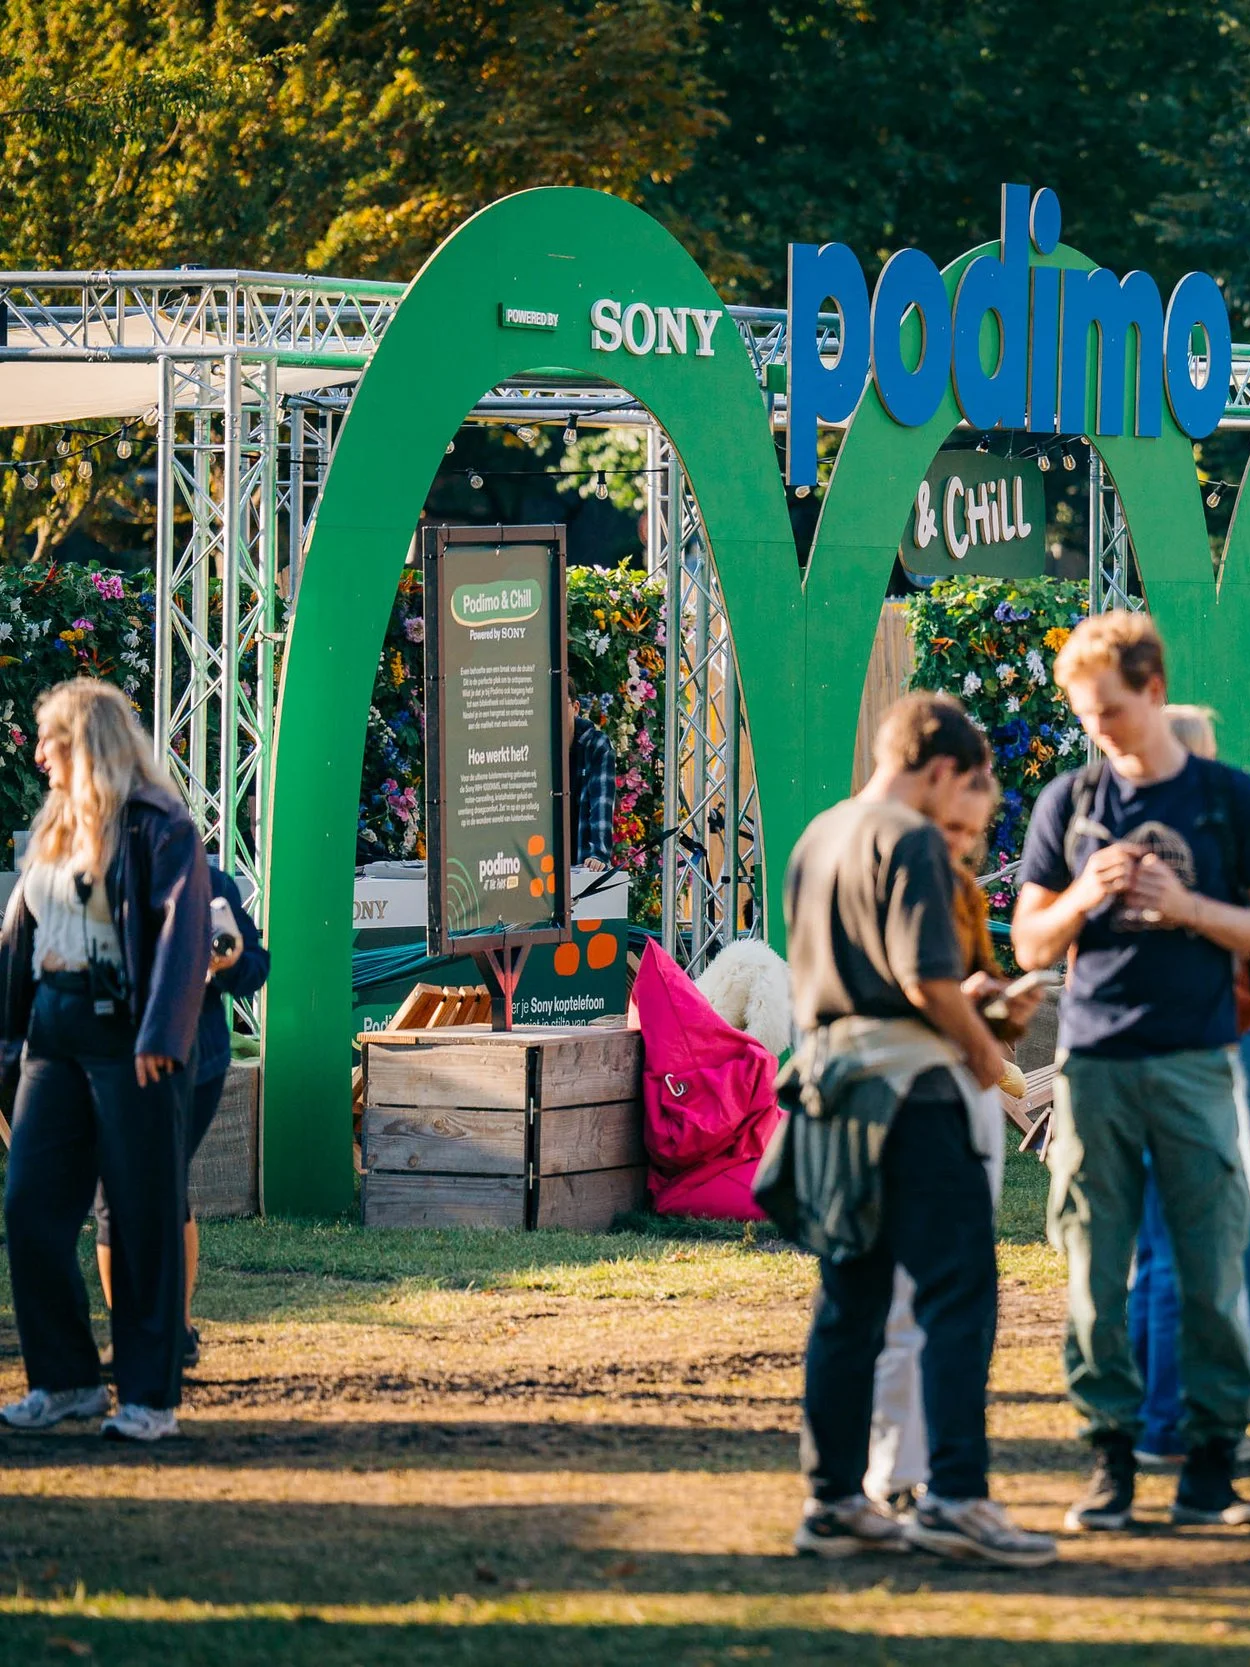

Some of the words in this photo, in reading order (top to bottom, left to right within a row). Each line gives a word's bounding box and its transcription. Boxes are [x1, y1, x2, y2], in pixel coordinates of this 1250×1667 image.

[506, 308, 547, 326] POWERED
[547, 313, 559, 327] BY
[591, 298, 723, 356] SONY
[785, 182, 1232, 486] podimo
[913, 480, 938, 549] &
[463, 593, 500, 614] Podimo
[501, 589, 509, 610] &
[510, 588, 532, 609] Chill
[469, 628, 494, 641] Powered
[494, 627, 501, 642] by
[501, 627, 526, 639] SONY
[468, 748, 485, 765] Hoe
[486, 746, 510, 763] werkt
[510, 744, 529, 762] het?
[479, 851, 520, 882] podimo
[353, 900, 388, 920] ONY
[520, 998, 529, 1018] je
[531, 997, 553, 1016] Sony
[554, 994, 604, 1015] koptelefoon
